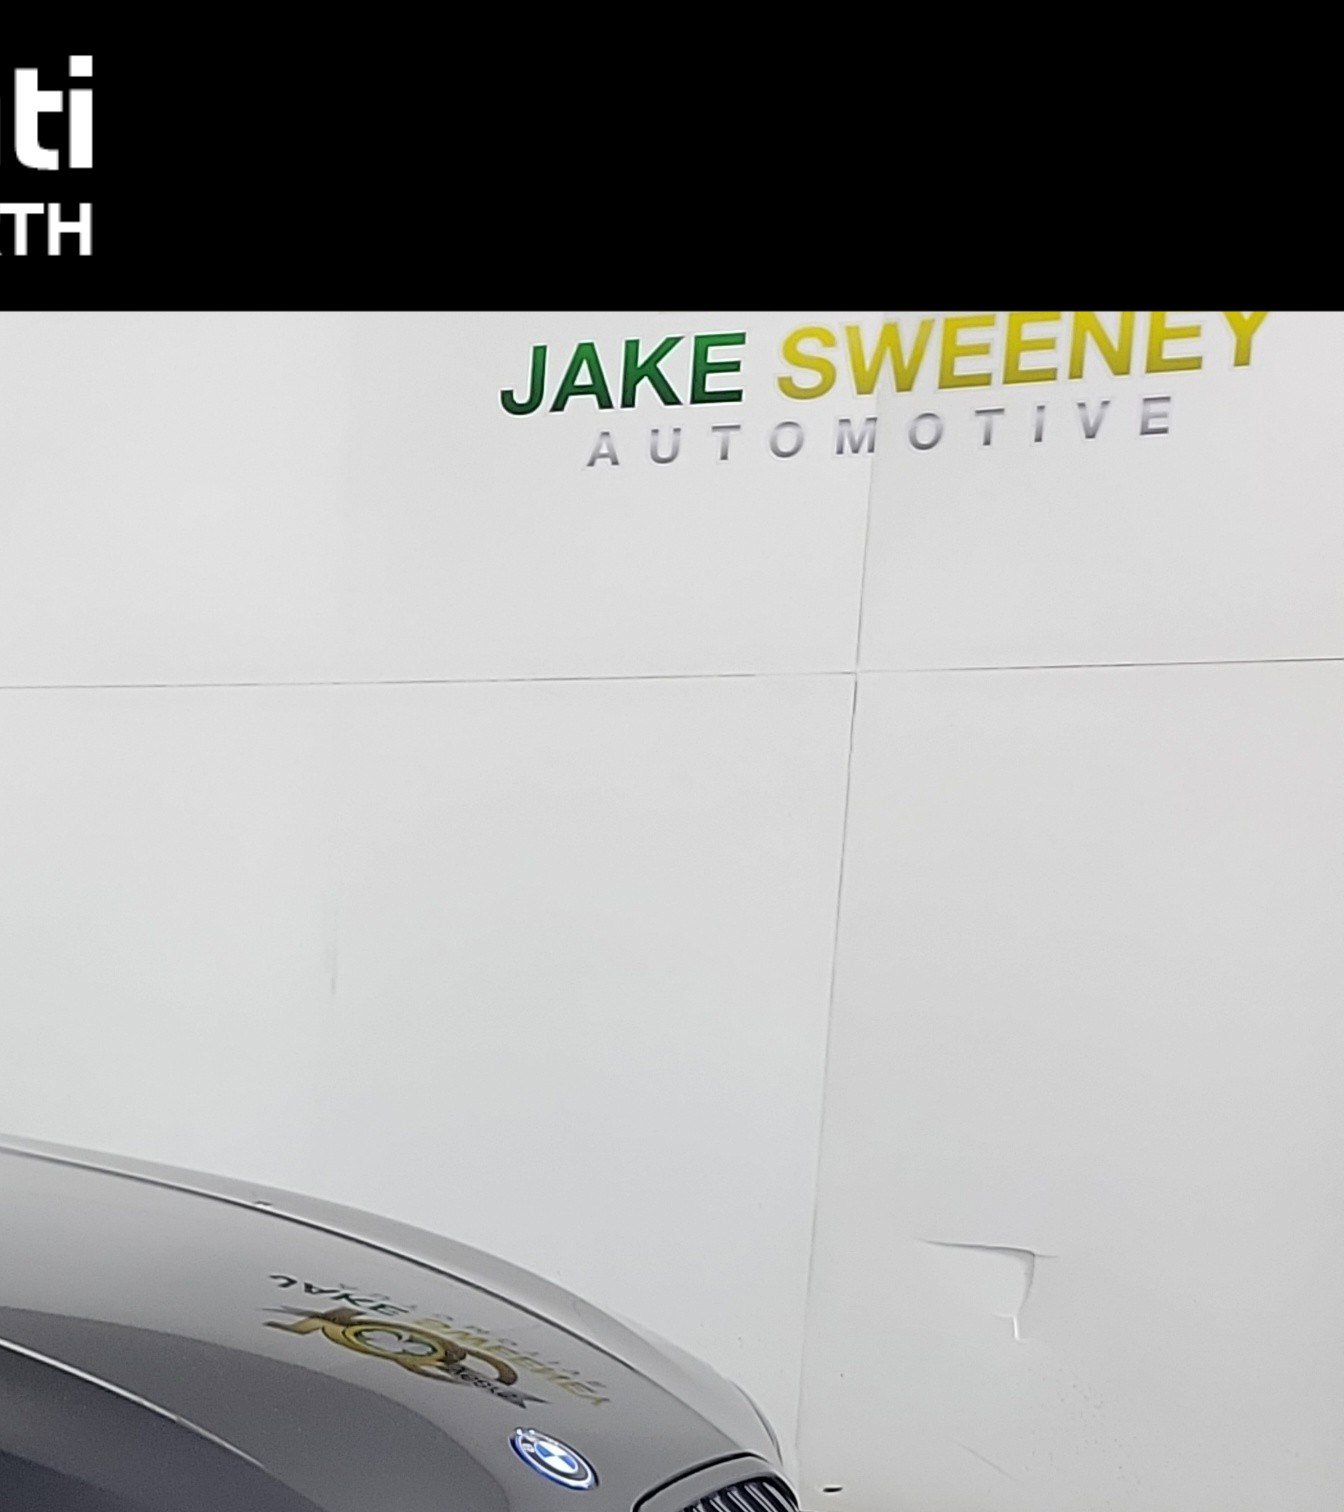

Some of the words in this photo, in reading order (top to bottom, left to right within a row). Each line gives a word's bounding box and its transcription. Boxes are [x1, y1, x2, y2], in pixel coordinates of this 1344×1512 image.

[500, 331, 747, 416] JAKE
[776, 311, 1270, 400] SWEENEY
[585, 395, 1172, 467] AUTOMOTIVE
